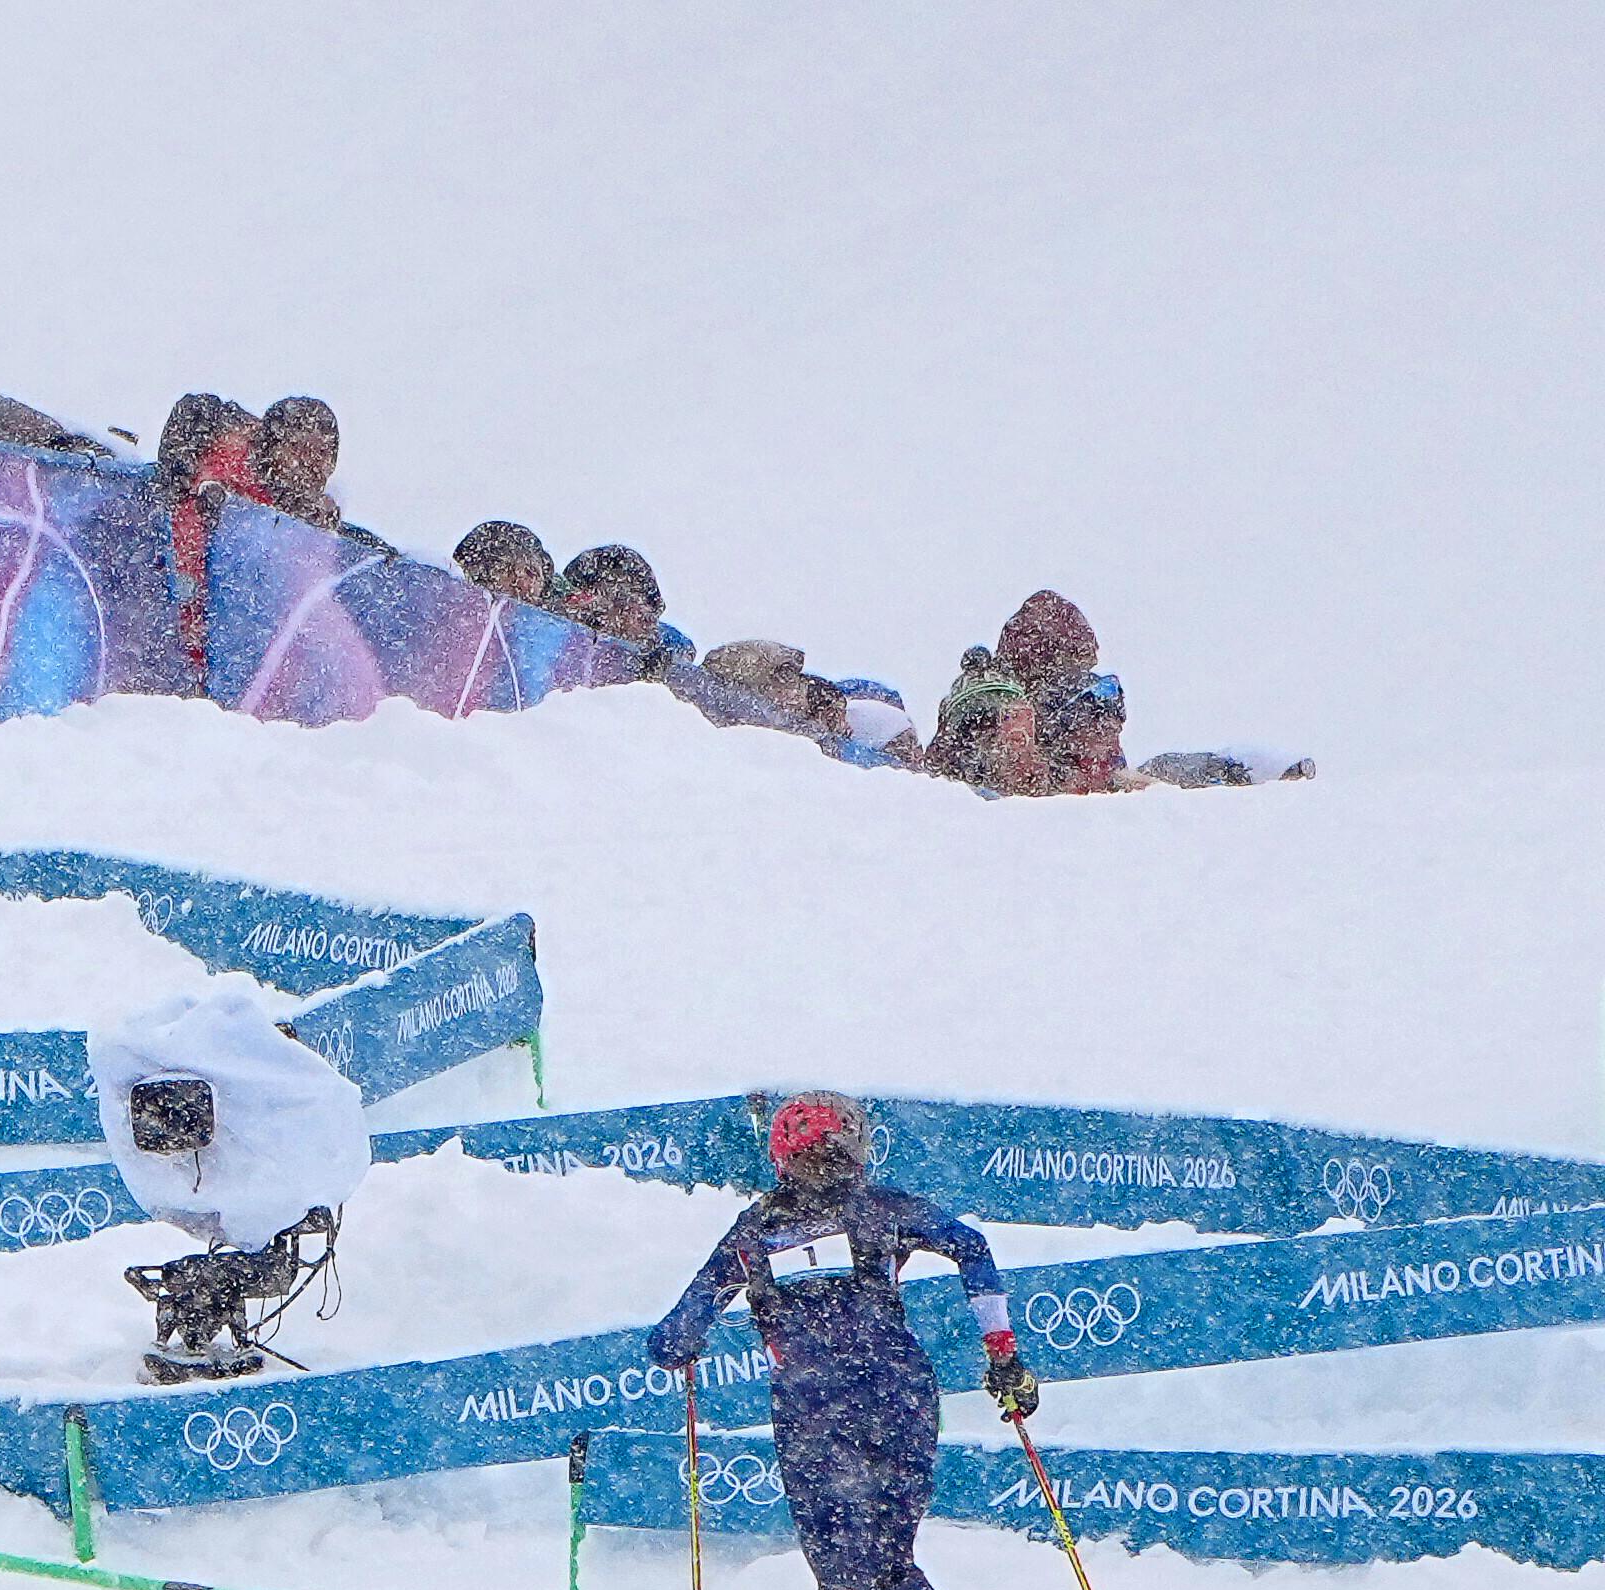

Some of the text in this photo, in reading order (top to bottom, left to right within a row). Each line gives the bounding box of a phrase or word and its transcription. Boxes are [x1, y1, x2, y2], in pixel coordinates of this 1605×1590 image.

[240, 922, 327, 960] MILANO
[397, 998, 443, 1045] MILANO
[442, 973, 496, 1021] CORTINA
[503, 1150, 586, 1176] TINA
[982, 1147, 1237, 1190] MILANO CORTINA 2026
[802, 1245, 818, 1267] 1
[1300, 1242, 1605, 1309] MILANO CORTIN
[458, 1374, 611, 1422] MILANO
[988, 1478, 1478, 1519] MILANO CORTINA 2026
